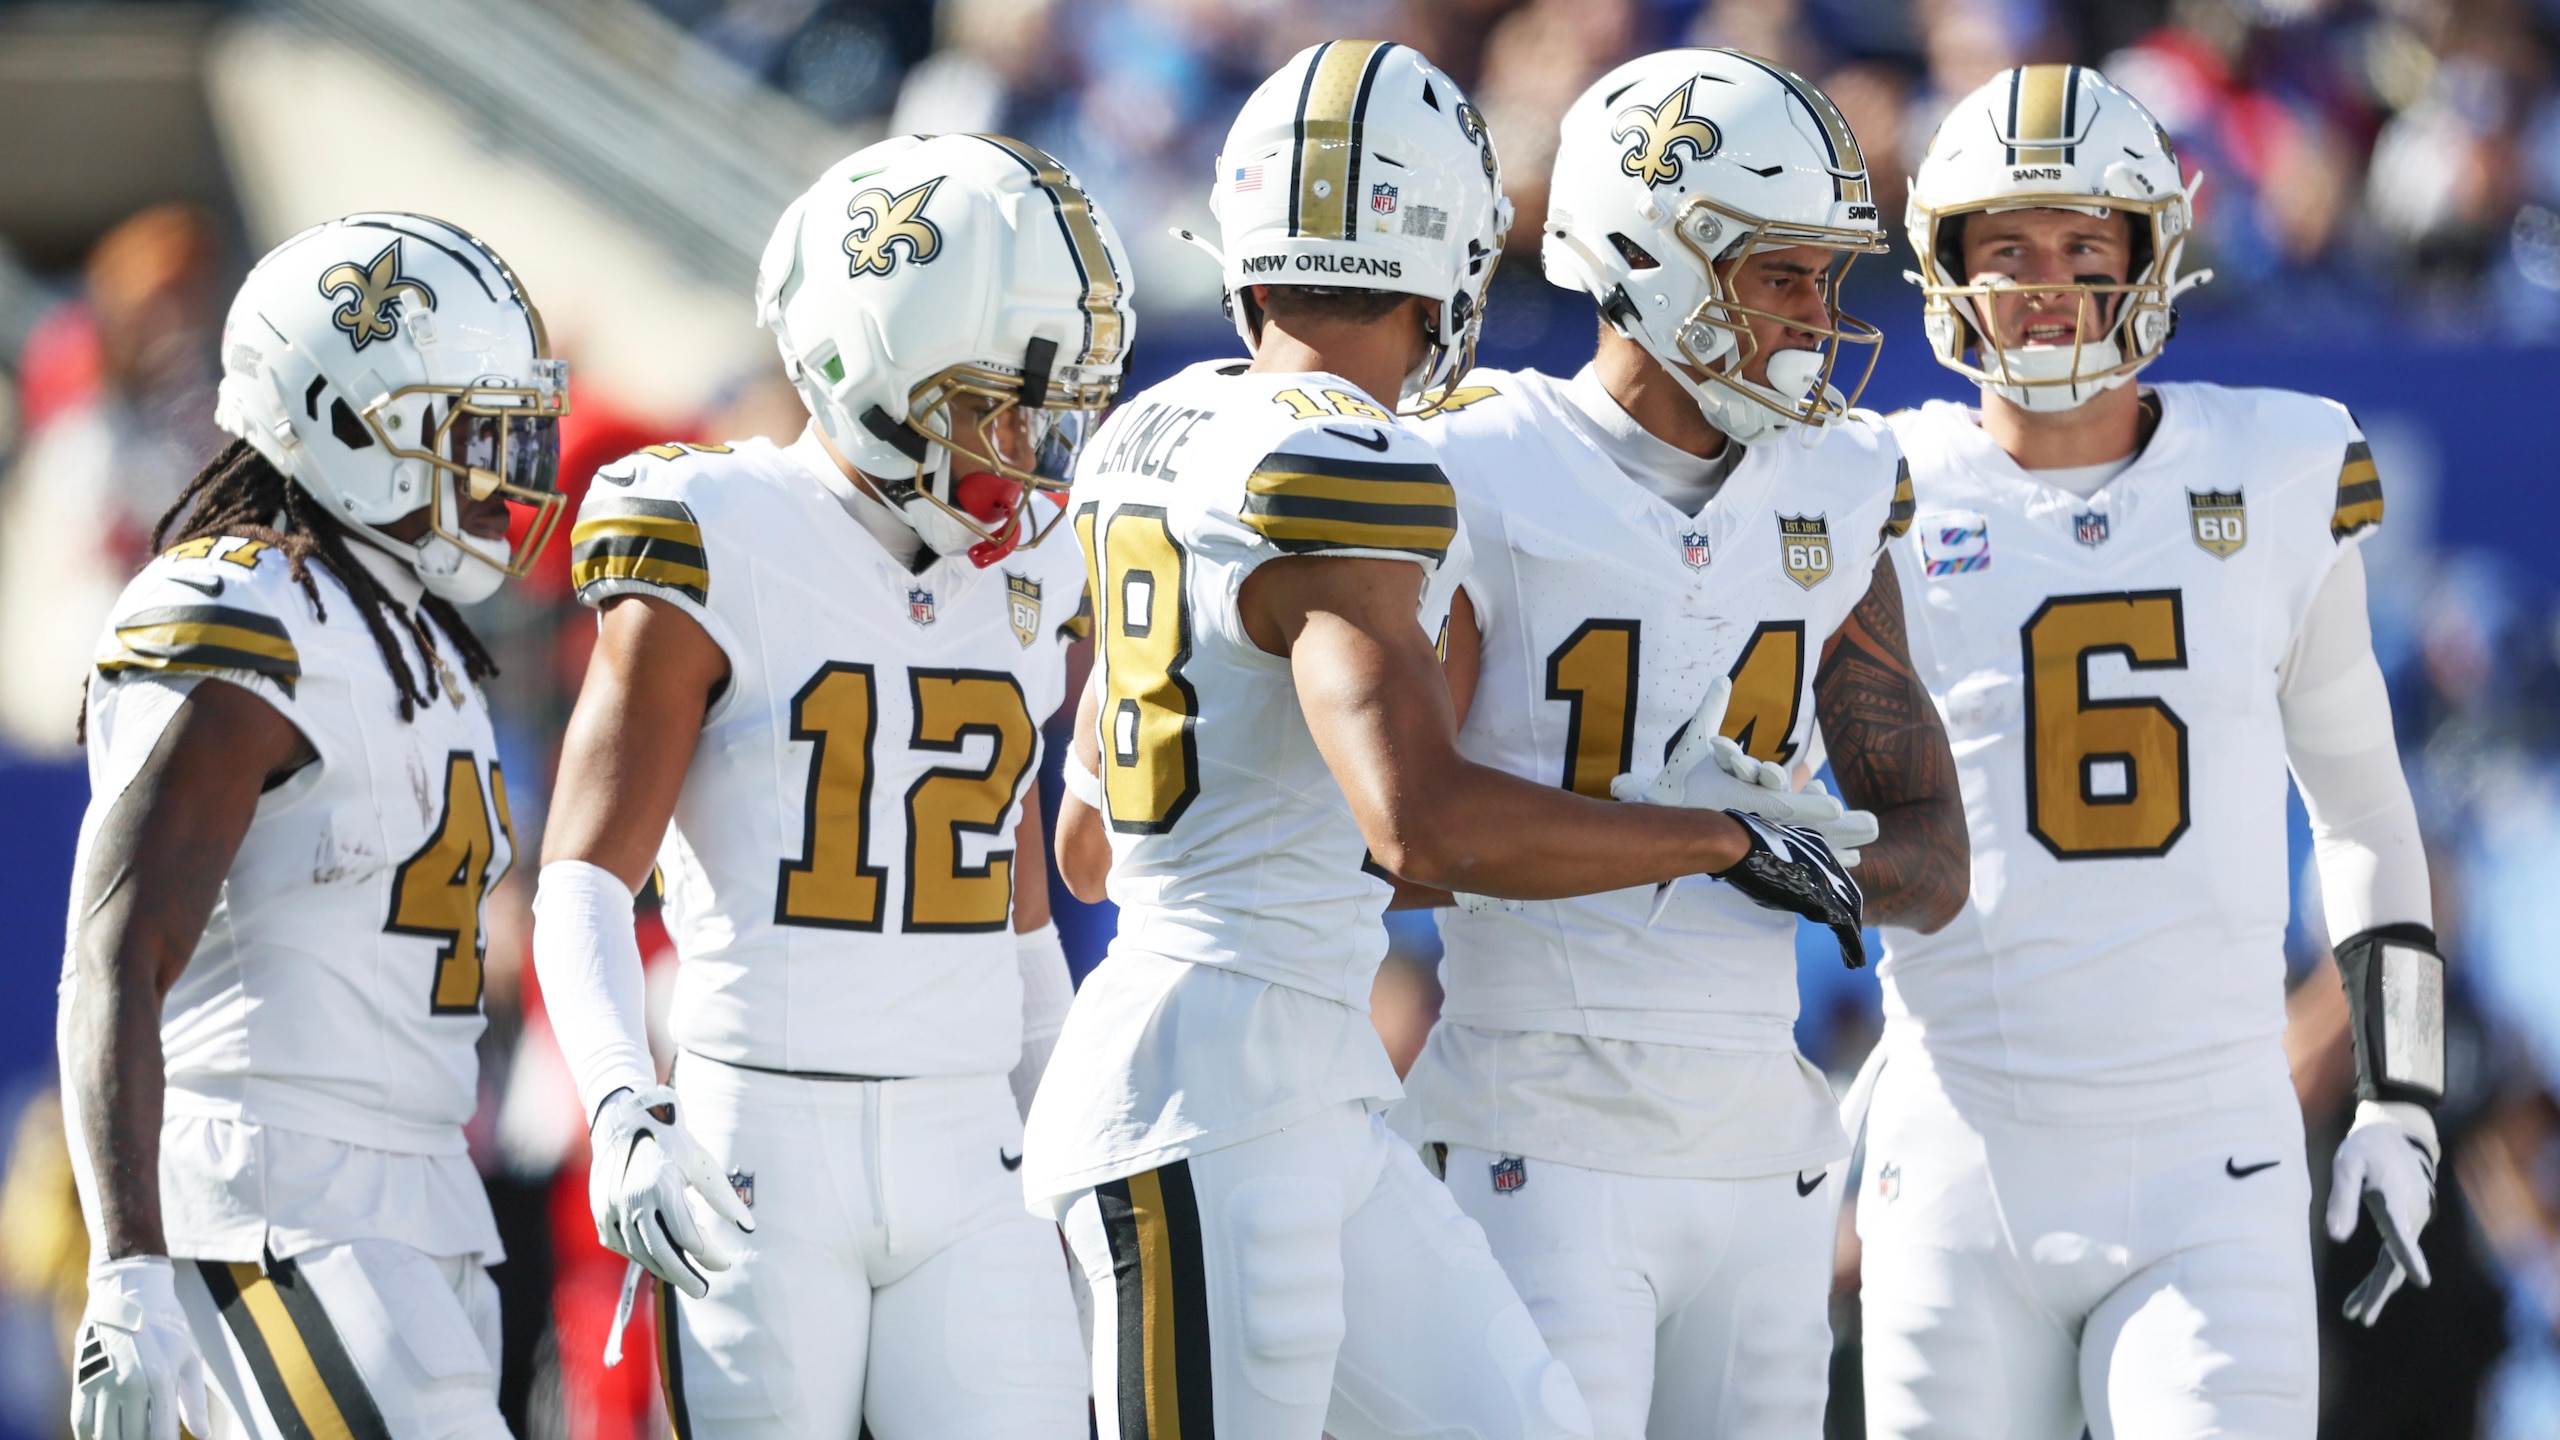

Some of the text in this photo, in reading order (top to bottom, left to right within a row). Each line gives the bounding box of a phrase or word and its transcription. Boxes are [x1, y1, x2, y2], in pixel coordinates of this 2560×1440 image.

[2012, 168, 2062, 181] SAINTS
[1374, 195, 1394, 212] NFL
[1272, 388, 1396, 424] 18
[1096, 400, 1216, 483] LANCE
[2080, 525, 2107, 543] NFL
[2197, 517, 2242, 542] 60
[1687, 547, 1708, 565] NFL
[1787, 544, 1829, 572] 60
[911, 603, 933, 622] NFL
[1013, 602, 1038, 635] 60
[2020, 588, 2191, 862] 6
[773, 660, 1037, 934] 12
[1497, 1170, 1523, 1189] NFL
